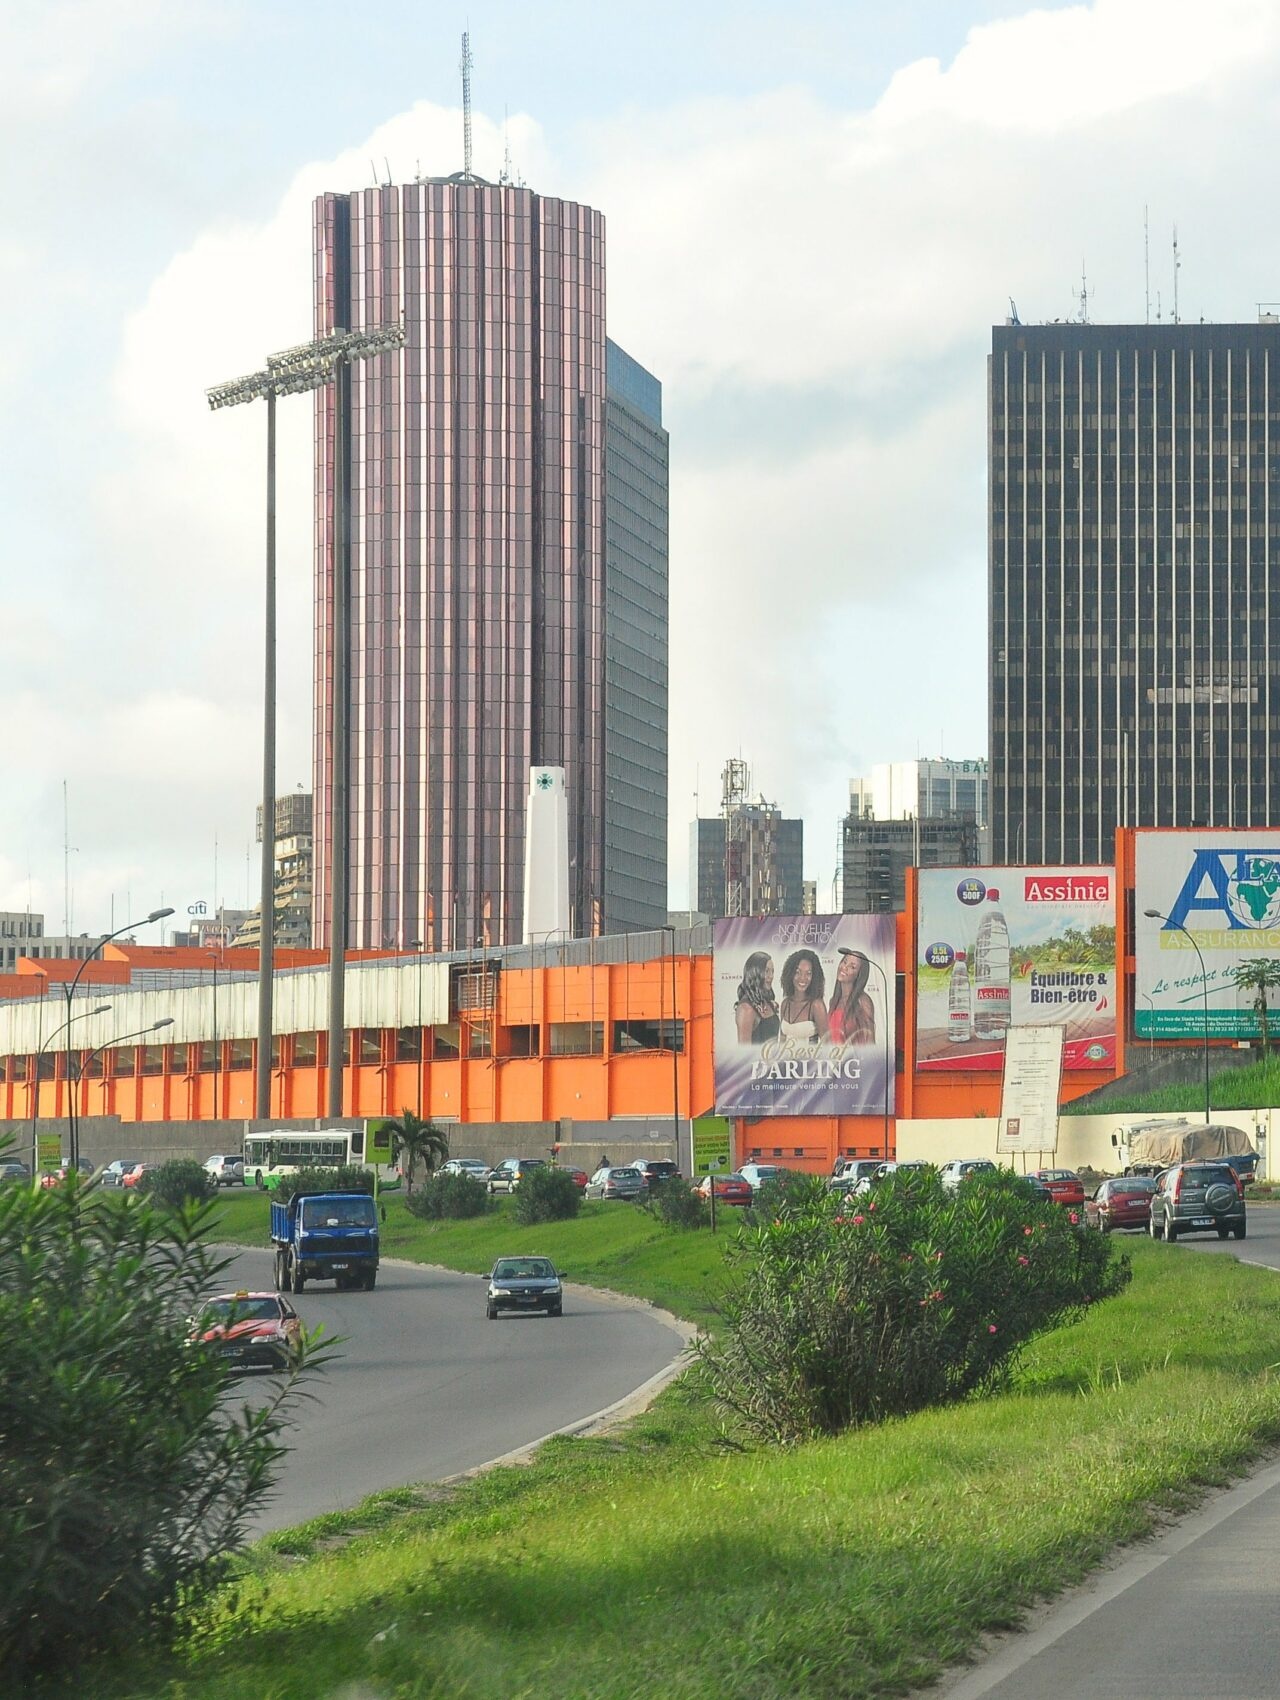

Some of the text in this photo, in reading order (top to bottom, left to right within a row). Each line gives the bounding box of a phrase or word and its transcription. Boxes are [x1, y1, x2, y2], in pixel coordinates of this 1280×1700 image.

[962, 891, 981, 900] 500F
[1027, 878, 1108, 901] Assinie
[187, 900, 207, 915] citi
[778, 922, 831, 934] NOUVELLE
[771, 933, 838, 945] COLLECTION
[931, 955, 949, 964] 250F
[1030, 969, 1108, 988] Équilibre &
[1152, 979, 1169, 995] Le
[1174, 969, 1217, 988] respect
[1030, 988, 1097, 1004] Bien-être
[750, 1058, 862, 1080] DARLING
[751, 1083, 761, 1091] La
[762, 1082, 797, 1091] meilleure
[828, 1082, 839, 1090] de
